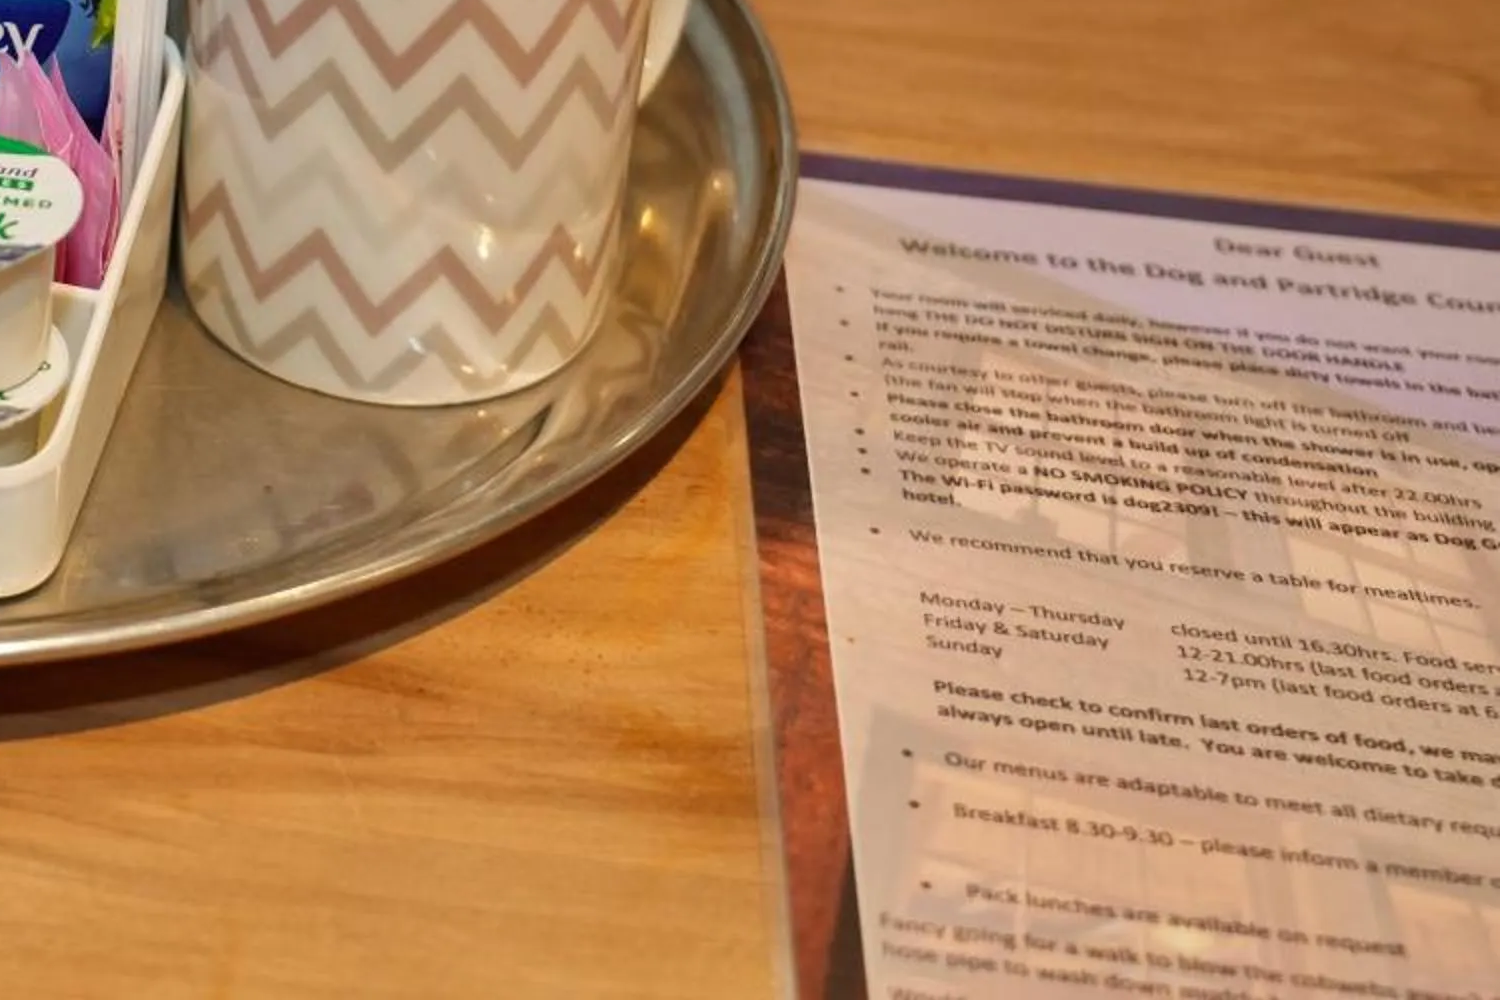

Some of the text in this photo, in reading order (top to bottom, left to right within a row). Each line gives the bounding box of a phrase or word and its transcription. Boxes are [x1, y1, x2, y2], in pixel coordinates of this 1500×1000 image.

[899, 239, 1037, 265] Welcome
[1046, 253, 1078, 269] to
[1087, 258, 1135, 276] the
[1145, 263, 1204, 287] Dog
[1214, 274, 1268, 290] and
[1277, 278, 1416, 306] Partridge
[896, 450, 928, 463] We
[934, 457, 1010, 473] operate
[1018, 467, 1028, 475] a
[1033, 465, 1066, 479] NO
[1071, 471, 1171, 492] SMOKING
[1176, 483, 1247, 500] POLICY
[1254, 492, 1368, 515] throughout
[1374, 506, 1407, 519] the
[900, 469, 936, 484] The
[1000, 483, 1096, 503] password
[1102, 494, 1118, 506] is
[1242, 510, 1281, 525] this
[1285, 517, 1322, 530] will
[1329, 523, 1399, 539] appear
[1407, 531, 1429, 543] as
[1433, 533, 1477, 551] Dog
[908, 529, 1480, 609] We recommend that you reserve a table for mealtimes.
[920, 591, 1125, 630] Monday Thursday
[923, 613, 1109, 650] Friday & Saturday
[926, 635, 1002, 659] Sunday
[1171, 623, 1238, 643] closed
[1244, 635, 1293, 649] until
[1403, 651, 1458, 670] Food
[1184, 668, 1266, 690] 12-7pm
[1323, 685, 1374, 703] food
[1380, 695, 1452, 714] orders
[1458, 704, 1479, 717] at
[1361, 667, 1412, 686] food
[1418, 677, 1489, 695] orders
[933, 680, 1003, 701] Please
[1010, 692, 1073, 710] check
[1078, 700, 1103, 714] to
[1108, 705, 1194, 726] confirm
[1200, 714, 1240, 732] last
[1246, 723, 1320, 741] orders
[1325, 731, 1347, 745] of
[1419, 745, 1454, 759] we
[938, 705, 1013, 727] always
[1019, 717, 1076, 734] open
[1082, 726, 1133, 741] until
[1201, 738, 1245, 756] You
[1252, 747, 1287, 761] are
[1294, 753, 1397, 775] welcome
[1402, 765, 1429, 779] to
[1433, 769, 1484, 787] take
[944, 751, 986, 771] Our
[993, 762, 1068, 782] menus
[1075, 773, 1110, 787] are
[1117, 778, 1228, 803] adaptable
[1234, 792, 1259, 807] to
[1265, 797, 1322, 815] meet
[1331, 804, 1357, 819] all
[1363, 808, 1443, 833] dietary
[953, 803, 1059, 831] Breakfast
[1201, 839, 1274, 860] please
[1280, 849, 1359, 870] inform
[1365, 860, 1379, 874] a
[1385, 863, 1483, 886] member
